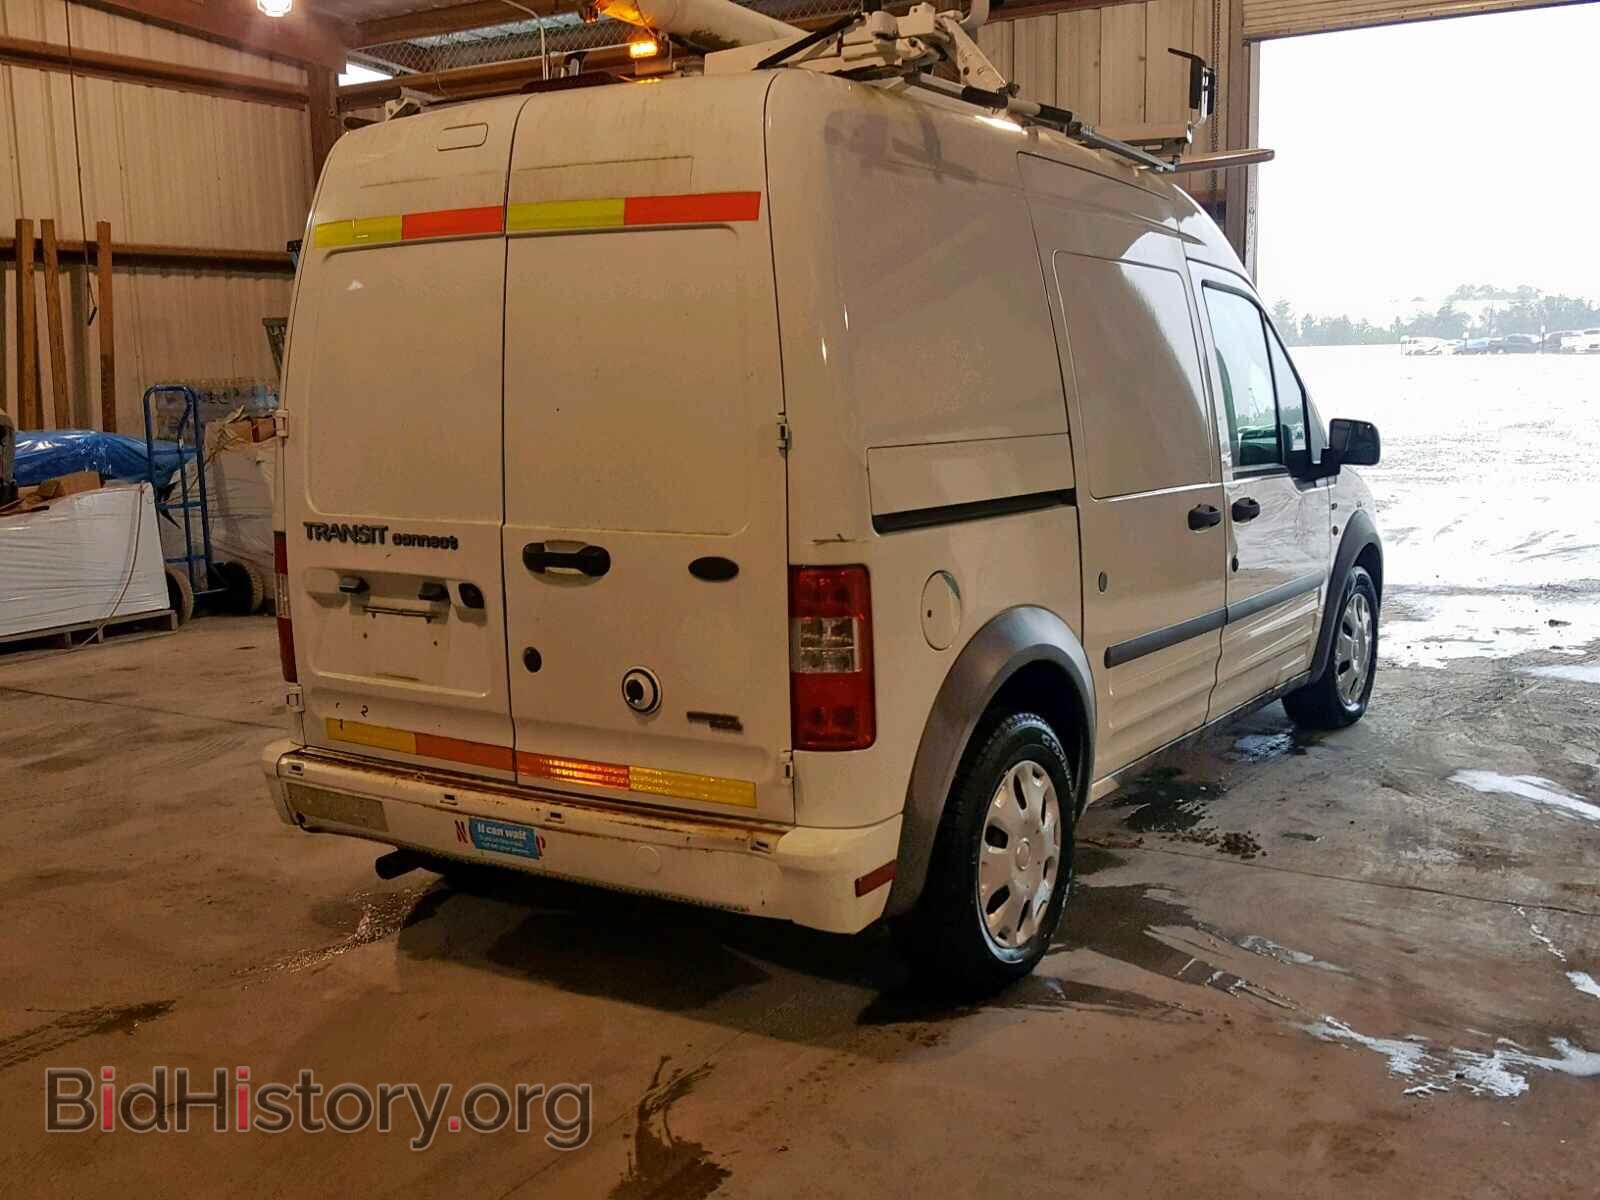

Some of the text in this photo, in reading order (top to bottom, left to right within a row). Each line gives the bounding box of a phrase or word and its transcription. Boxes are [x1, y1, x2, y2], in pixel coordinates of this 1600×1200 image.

[303, 522, 459, 551] TRANSIT connect
[486, 826, 503, 837] can
